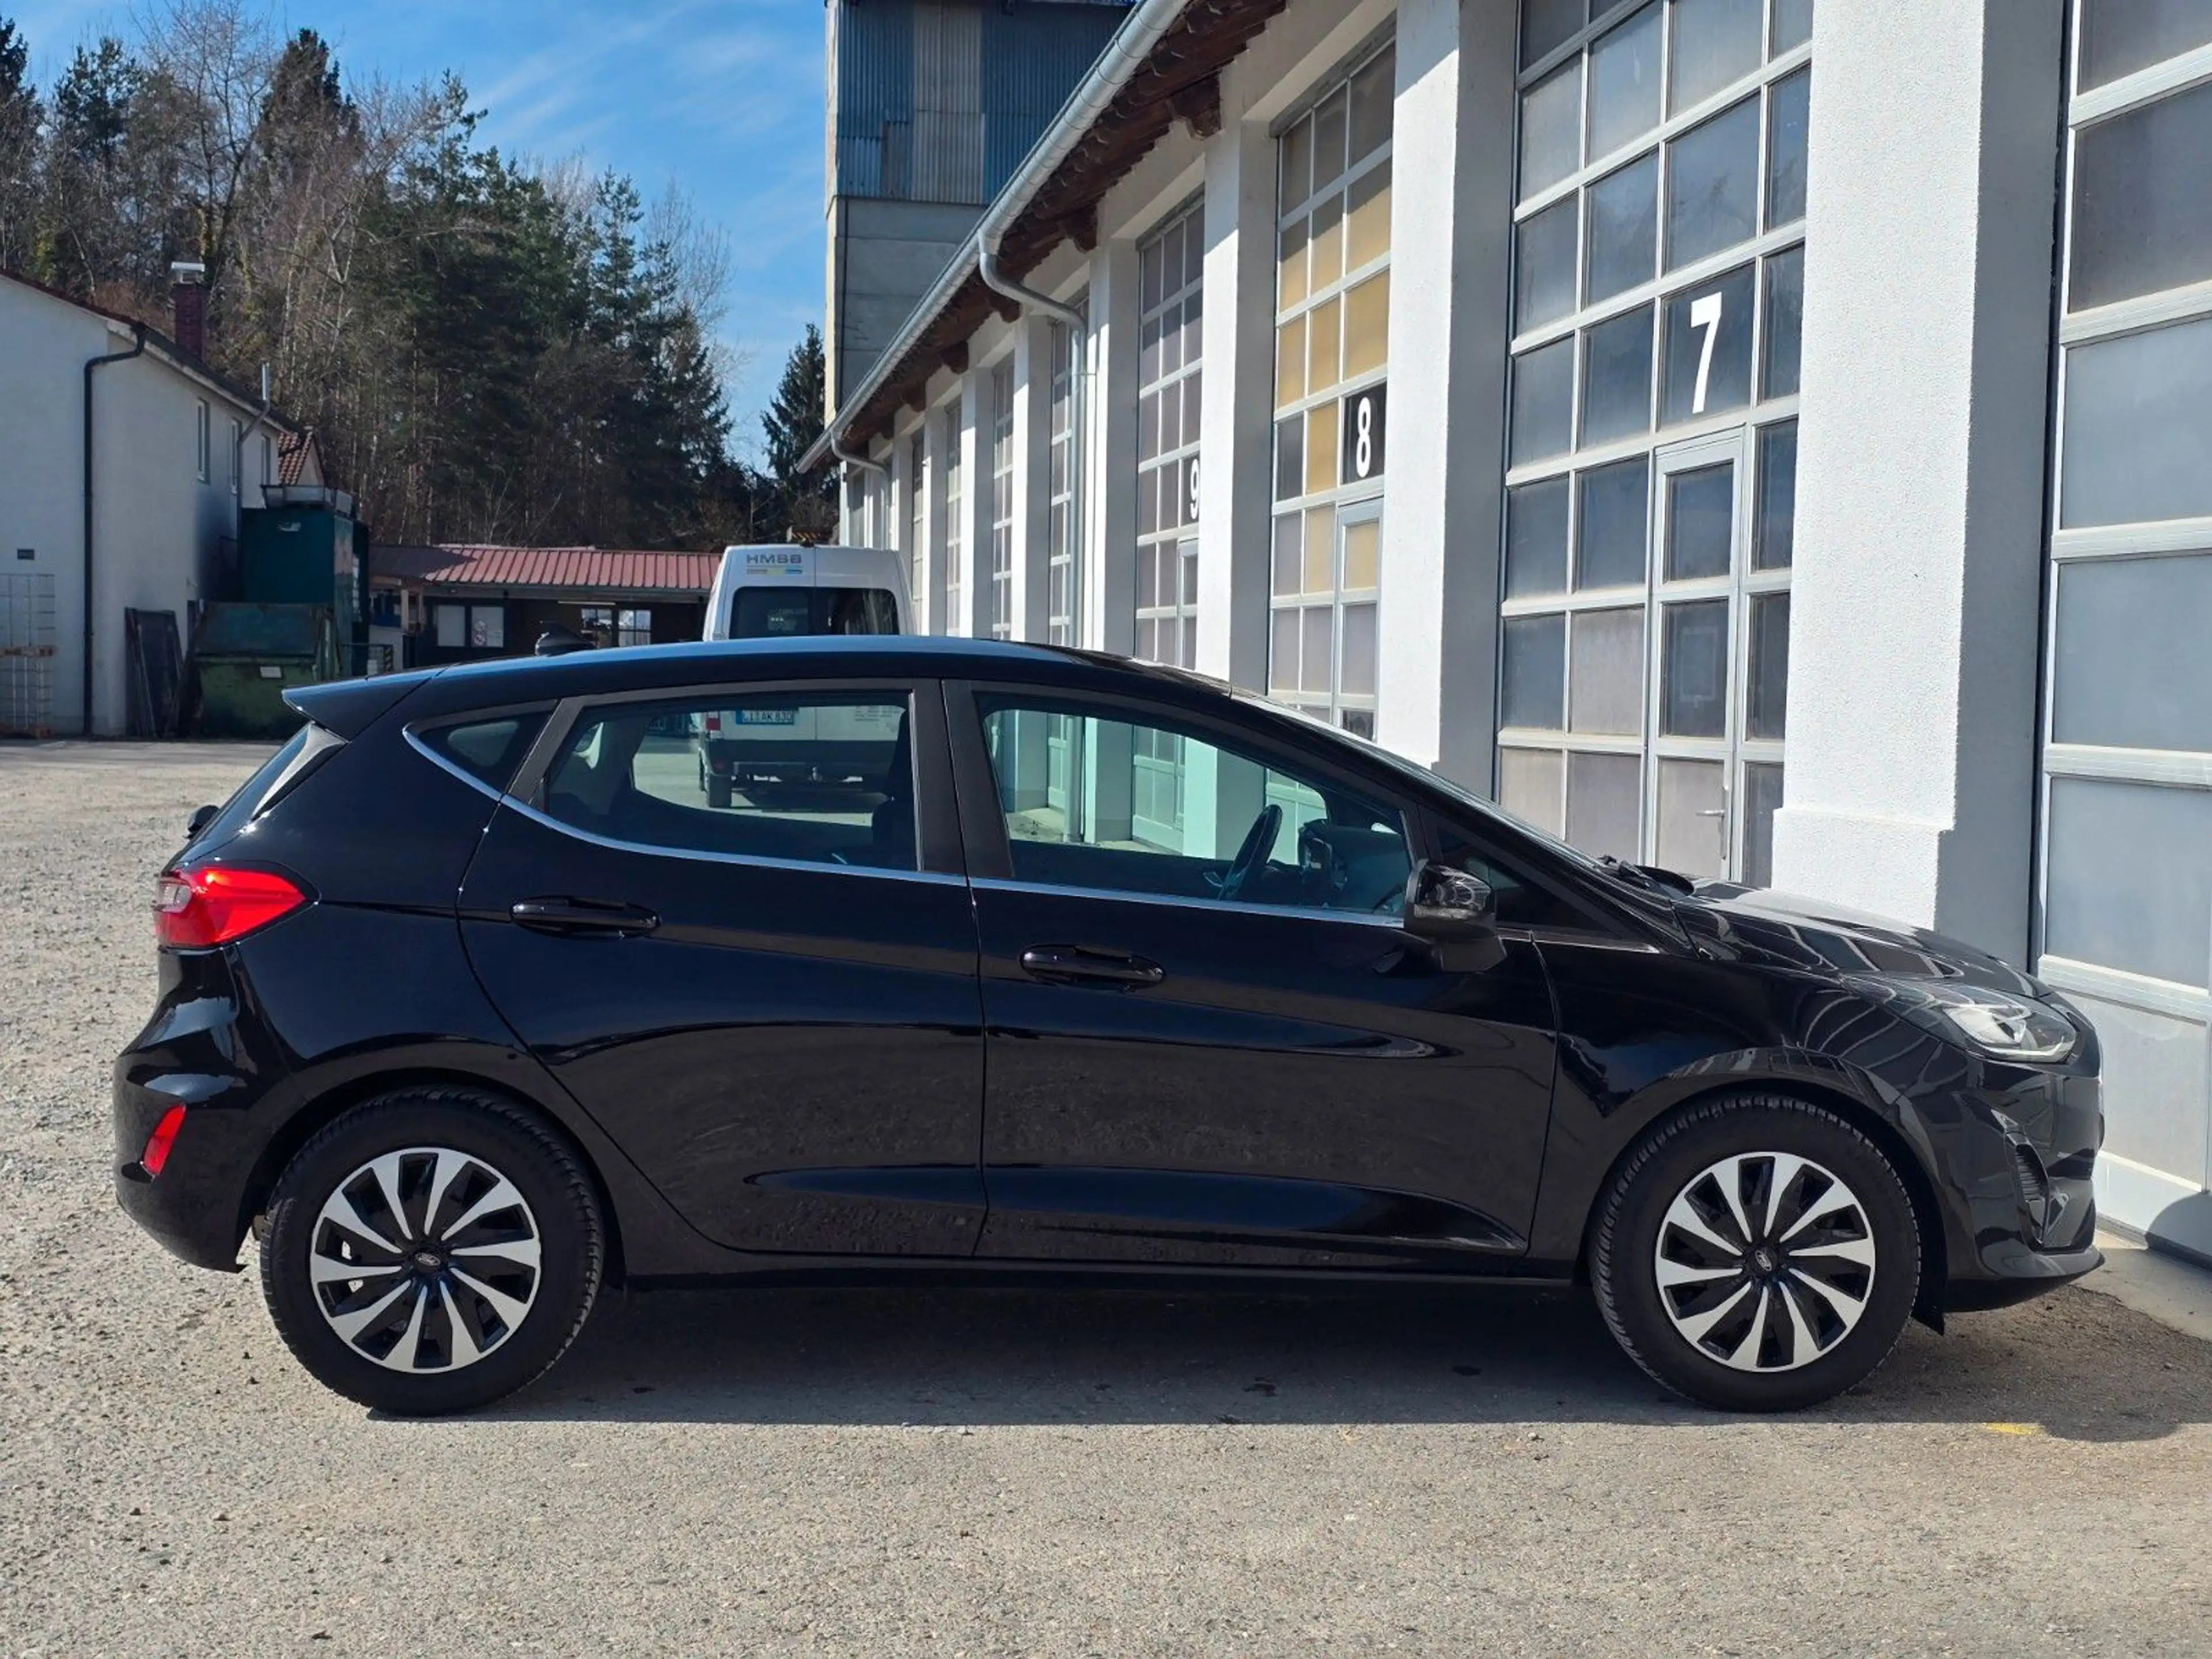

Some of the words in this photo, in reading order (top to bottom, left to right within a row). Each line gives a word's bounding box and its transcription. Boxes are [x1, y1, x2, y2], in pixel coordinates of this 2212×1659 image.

[1691, 291, 1722, 414] 7
[1356, 396, 1371, 478] 8
[1190, 459, 1199, 519] 9
